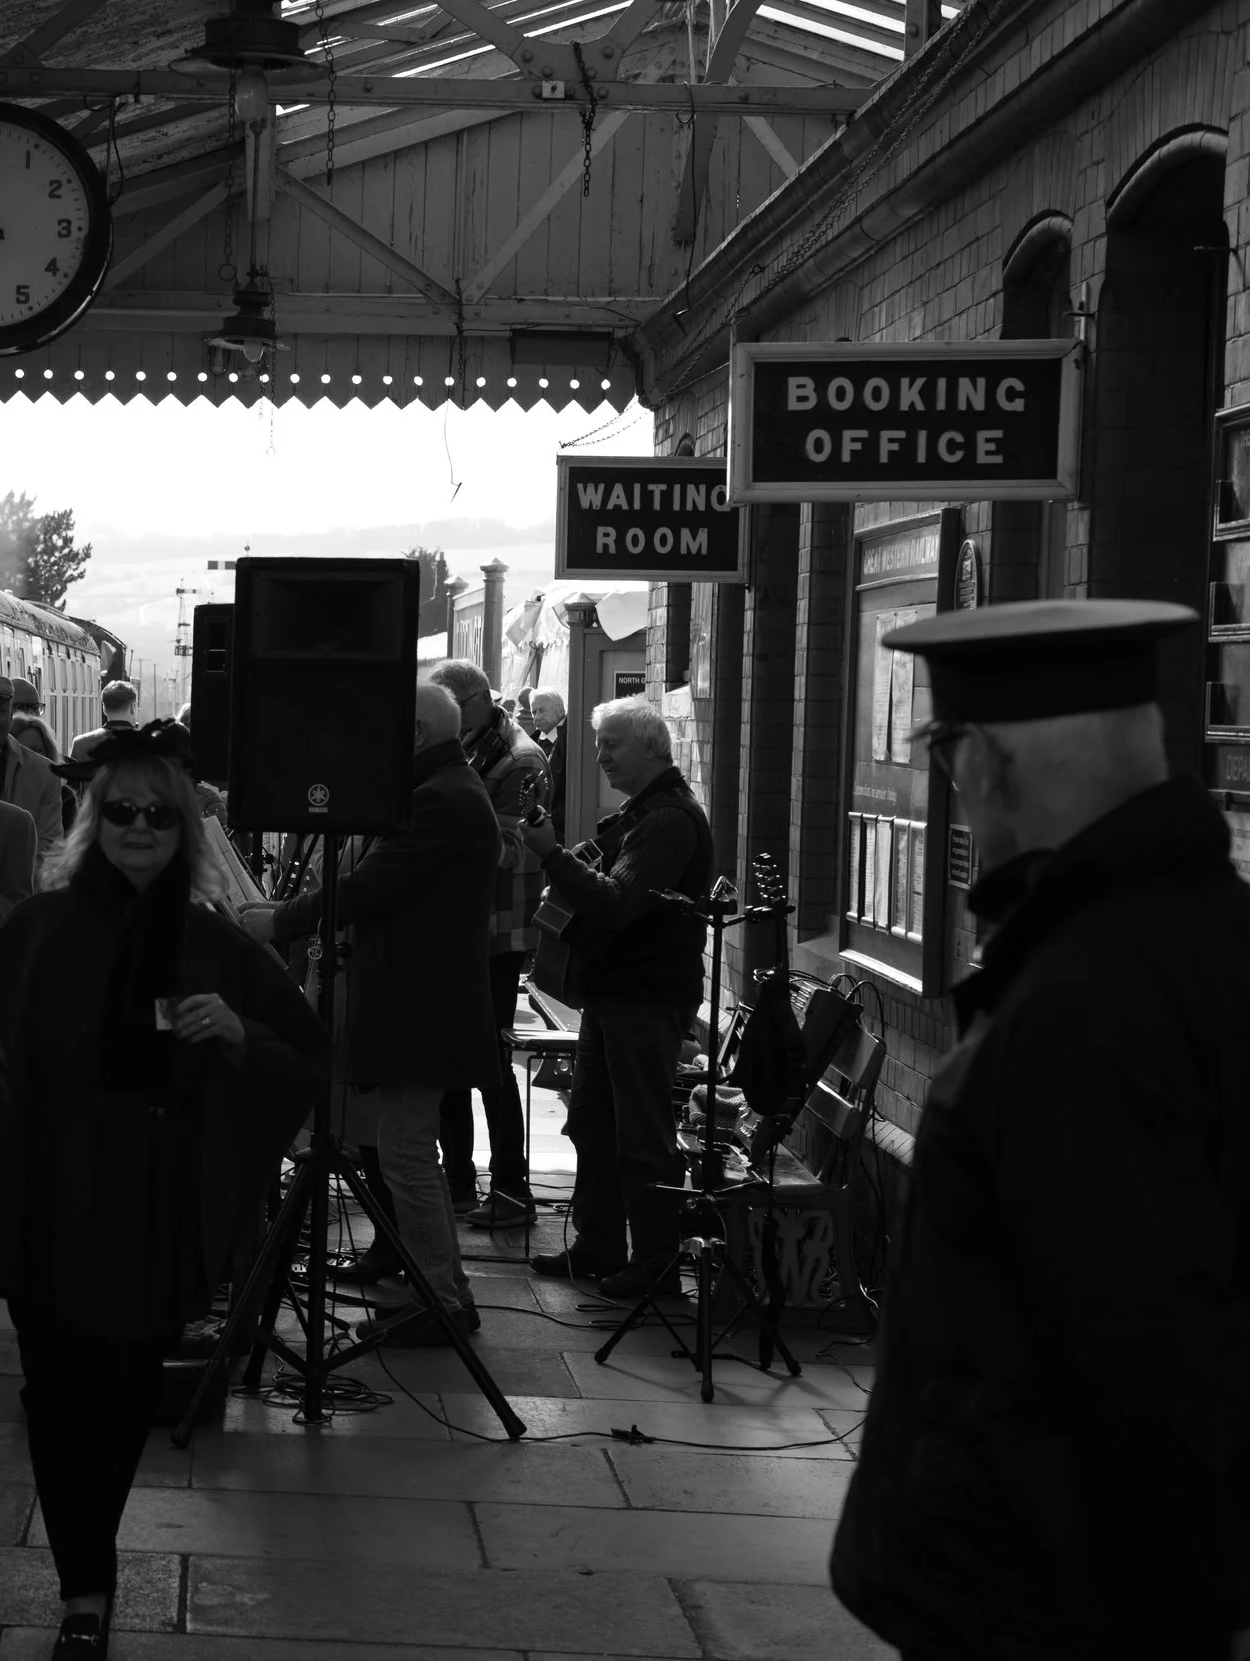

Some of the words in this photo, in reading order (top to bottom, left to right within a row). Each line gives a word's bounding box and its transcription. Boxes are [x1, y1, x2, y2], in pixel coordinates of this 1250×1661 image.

[25, 150, 31, 169] 1
[48, 180, 63, 199] 2
[57, 219, 72, 238] 3
[45, 257, 60, 276] 4
[15, 285, 30, 304] 5
[787, 376, 1026, 412] BOOKING
[804, 428, 1004, 464] OFFICE
[577, 482, 732, 512] WAITING
[595, 526, 709, 556] ROOM
[618, 676, 640, 685] NORTH
